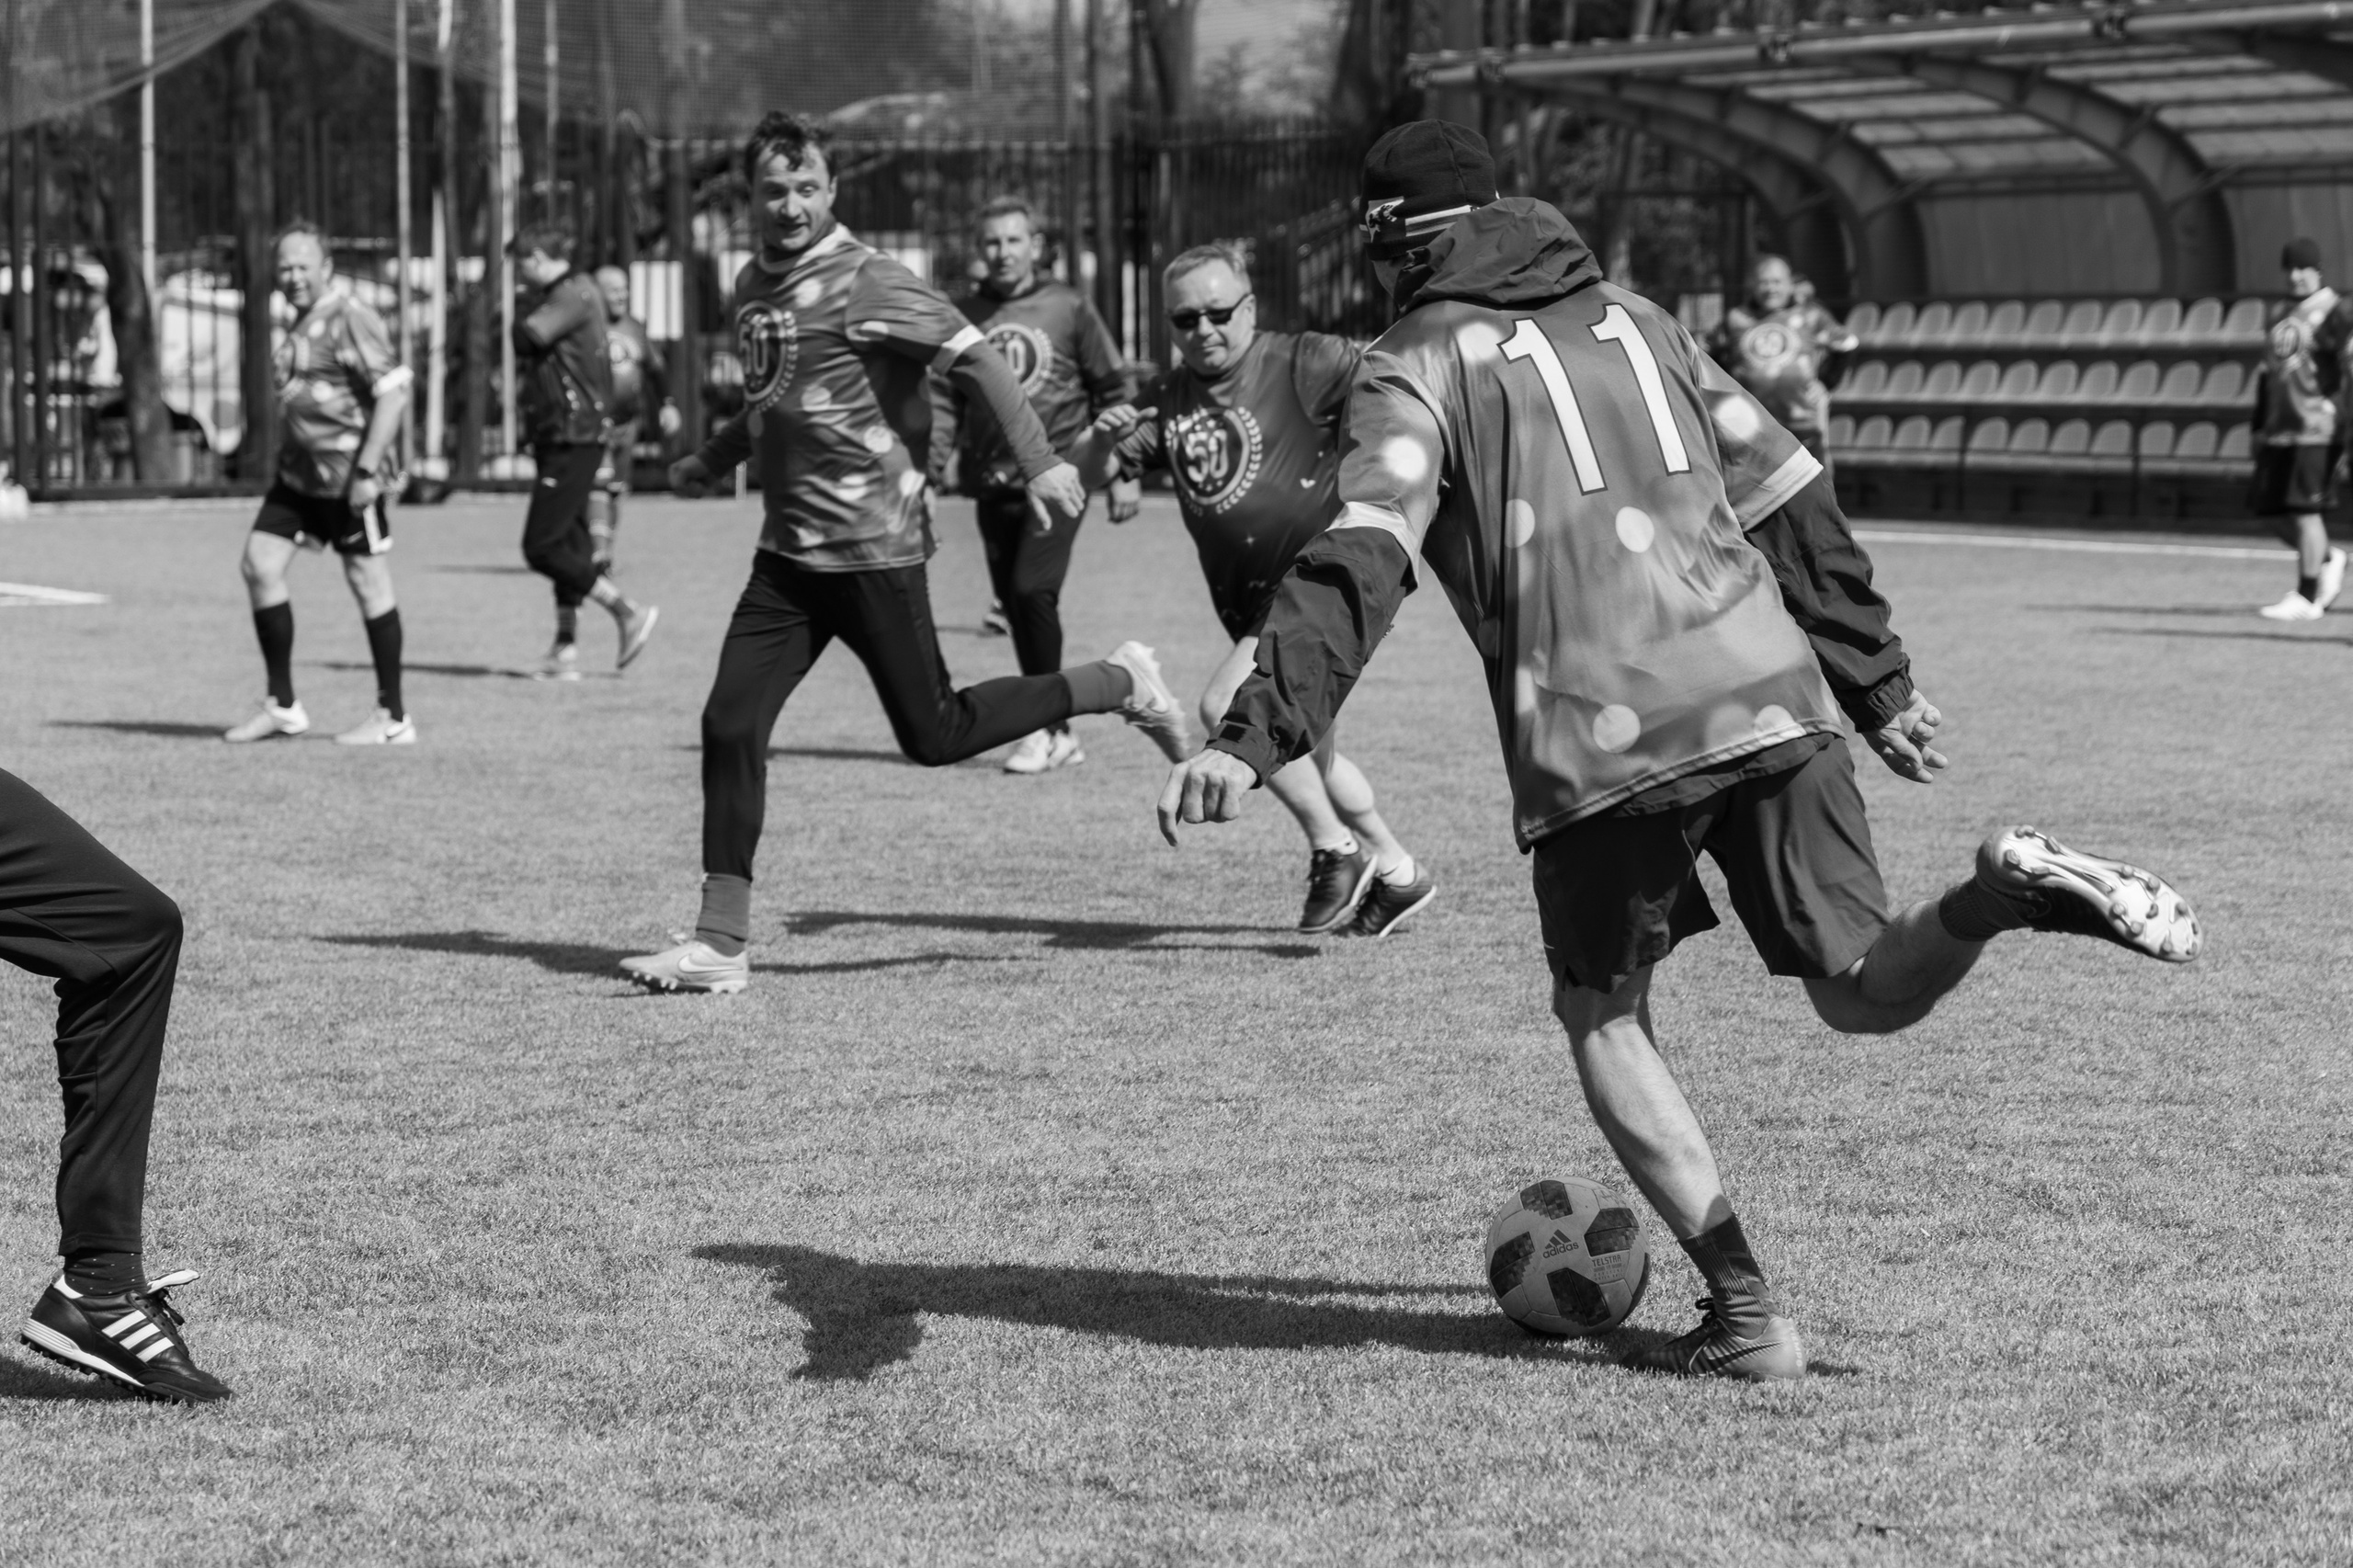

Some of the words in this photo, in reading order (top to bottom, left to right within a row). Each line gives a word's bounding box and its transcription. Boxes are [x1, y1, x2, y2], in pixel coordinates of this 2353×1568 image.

[1496, 302, 1692, 496] 11
[1185, 428, 1230, 483] 50
[1542, 1242, 1579, 1259] adidas
[1591, 1254, 1622, 1267] TELSTRA
